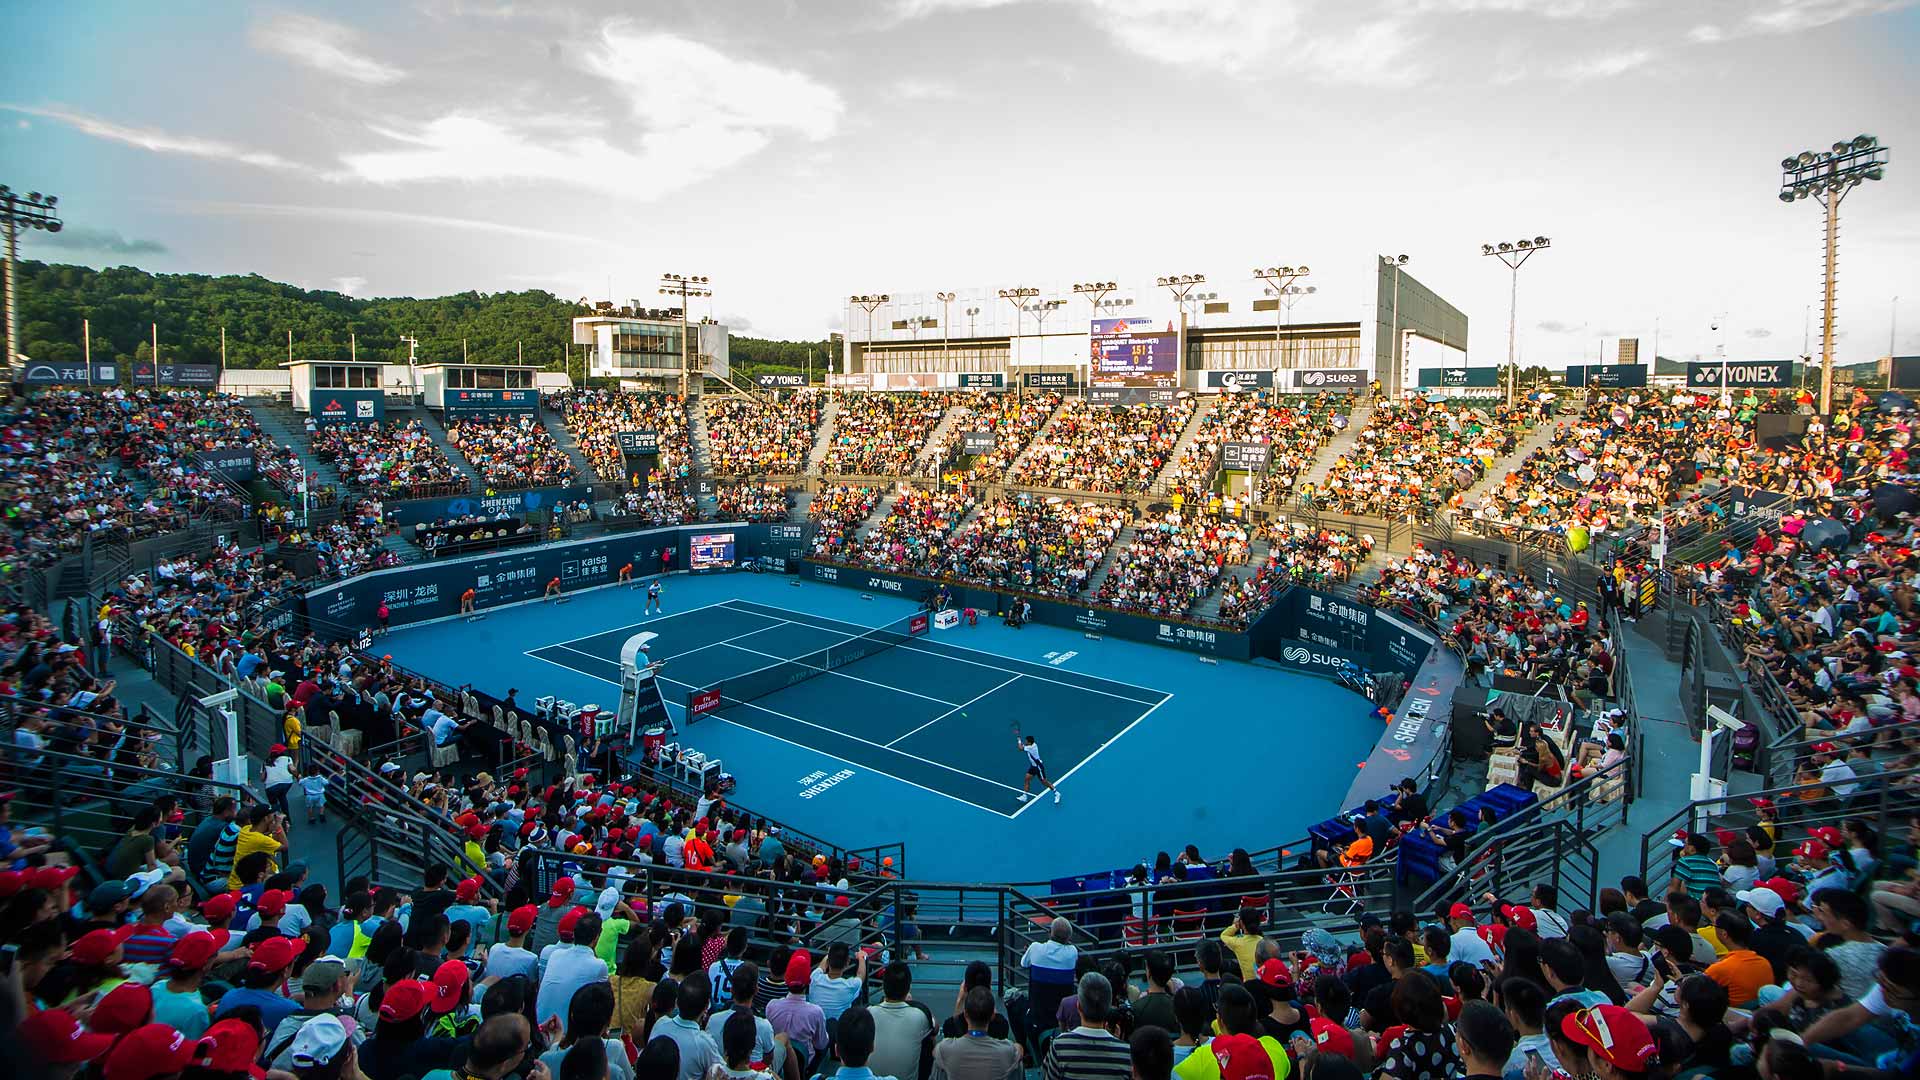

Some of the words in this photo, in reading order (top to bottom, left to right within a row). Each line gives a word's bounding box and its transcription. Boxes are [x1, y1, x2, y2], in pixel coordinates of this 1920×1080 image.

[777, 376, 804, 384] YONEX
[1727, 366, 1779, 383] YONEX
[481, 497, 520, 508] SHENZHEN
[488, 504, 515, 514] OPEN
[496, 568, 536, 582] 金地集团
[881, 580, 902, 592] YONEX
[944, 616, 958, 626] FedEx
[1328, 602, 1368, 626] 金地集团
[1176, 628, 1215, 643] 金地集团
[694, 698, 719, 712] Emirates
[800, 768, 856, 799] SHENZHEN
[538, 855, 544, 870] A
[687, 850, 697, 865] 16
